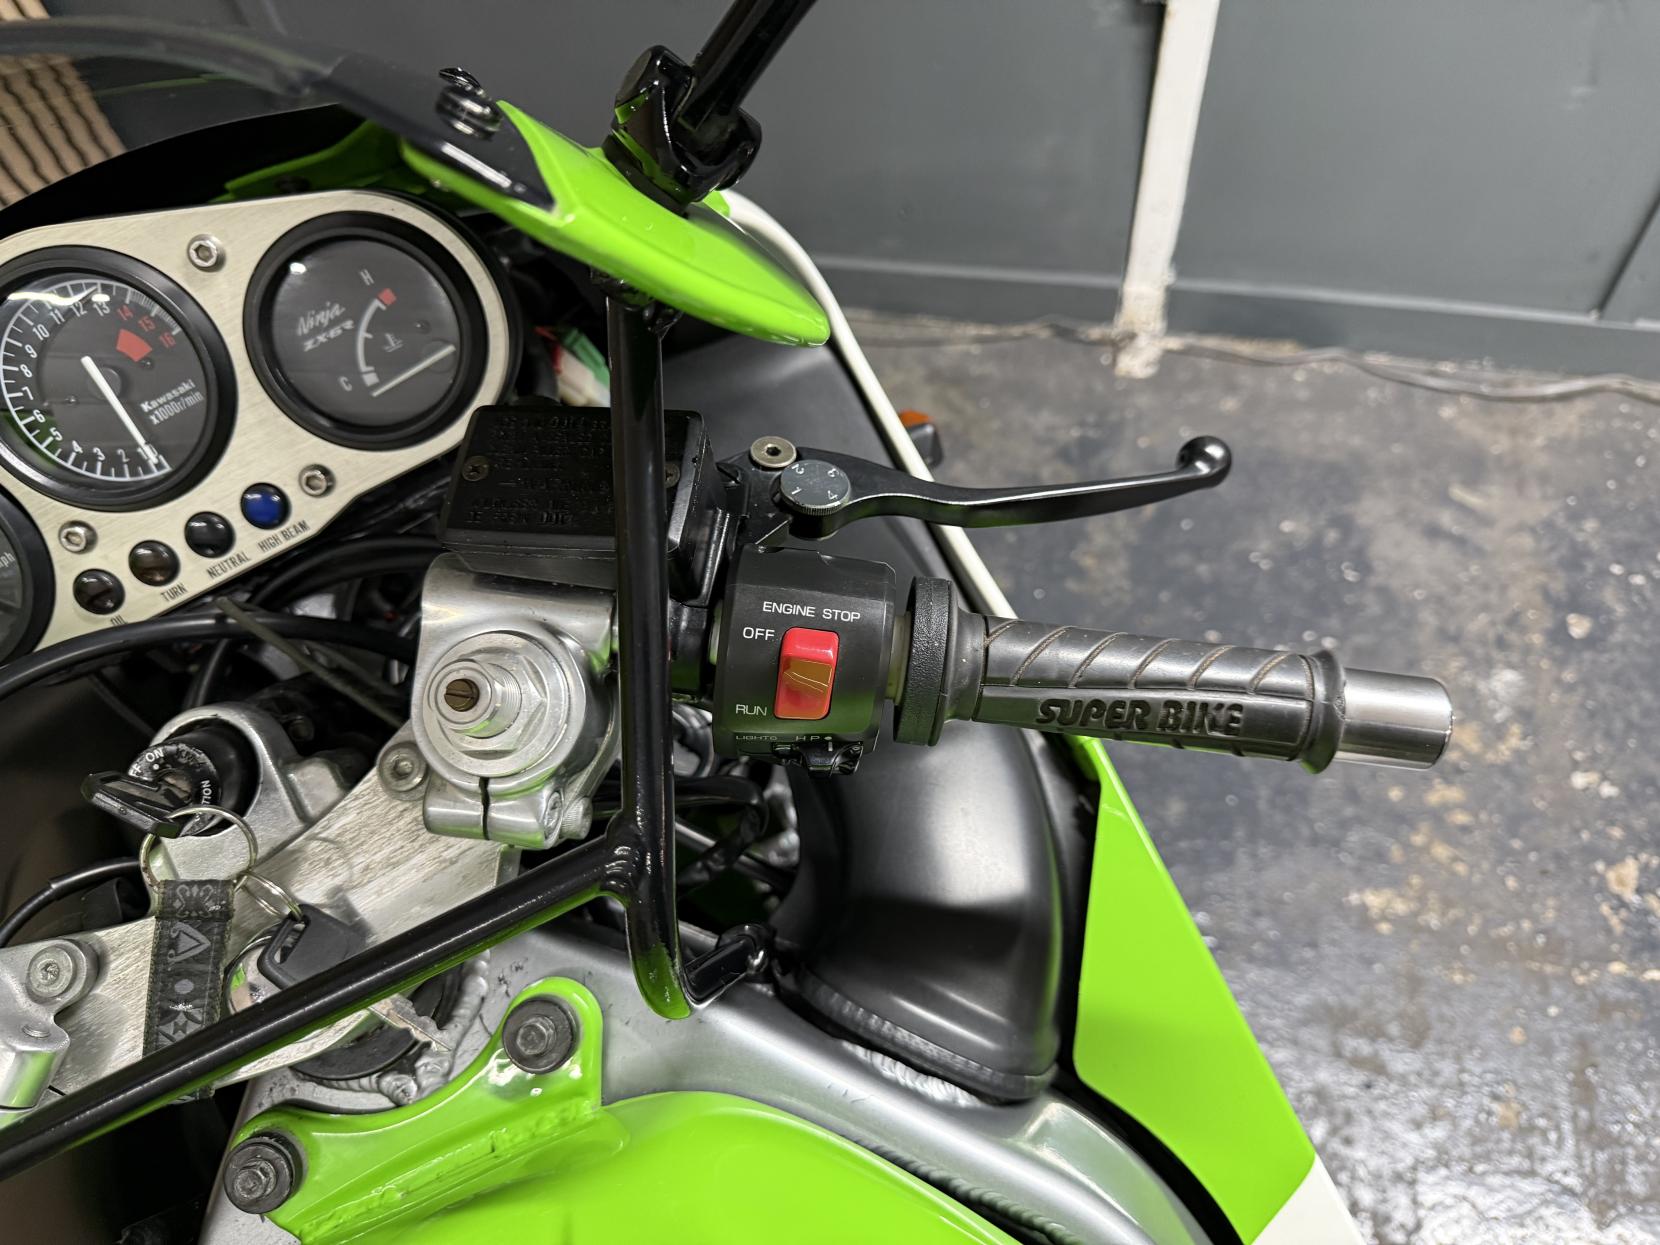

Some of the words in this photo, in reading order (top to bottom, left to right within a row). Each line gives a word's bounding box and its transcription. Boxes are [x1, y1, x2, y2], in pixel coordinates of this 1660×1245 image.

[358, 269, 374, 286] H
[70, 301, 87, 317] 12
[93, 300, 110, 316] 13
[117, 304, 134, 321] 14
[49, 309, 65, 325] 11
[138, 315, 156, 332] 15
[297, 301, 346, 336] Ninja
[32, 323, 50, 341] 10
[158, 331, 177, 348] 16
[24, 344, 37, 358] 9
[20, 364, 33, 378] 8
[338, 376, 353, 392] C
[21, 386, 34, 400] 7
[140, 378, 196, 413] Kawasaki
[33, 409, 46, 423] 6
[49, 427, 63, 441] 5
[71, 440, 84, 454] 4
[93, 447, 106, 461] 3
[116, 448, 130, 463] 2
[828, 490, 839, 500] 4
[257, 533, 282, 553] HIGH
[280, 520, 311, 542] BEAM
[205, 550, 251, 580] NEUTRAL
[160, 583, 189, 602] TURN
[762, 601, 816, 618] ENGINE
[822, 608, 861, 623] STOP
[742, 627, 775, 641] OFF
[735, 704, 768, 716] RUN
[1034, 698, 1151, 731] SUPER
[1156, 700, 1245, 737] BIKE
[145, 747, 165, 762] ON
